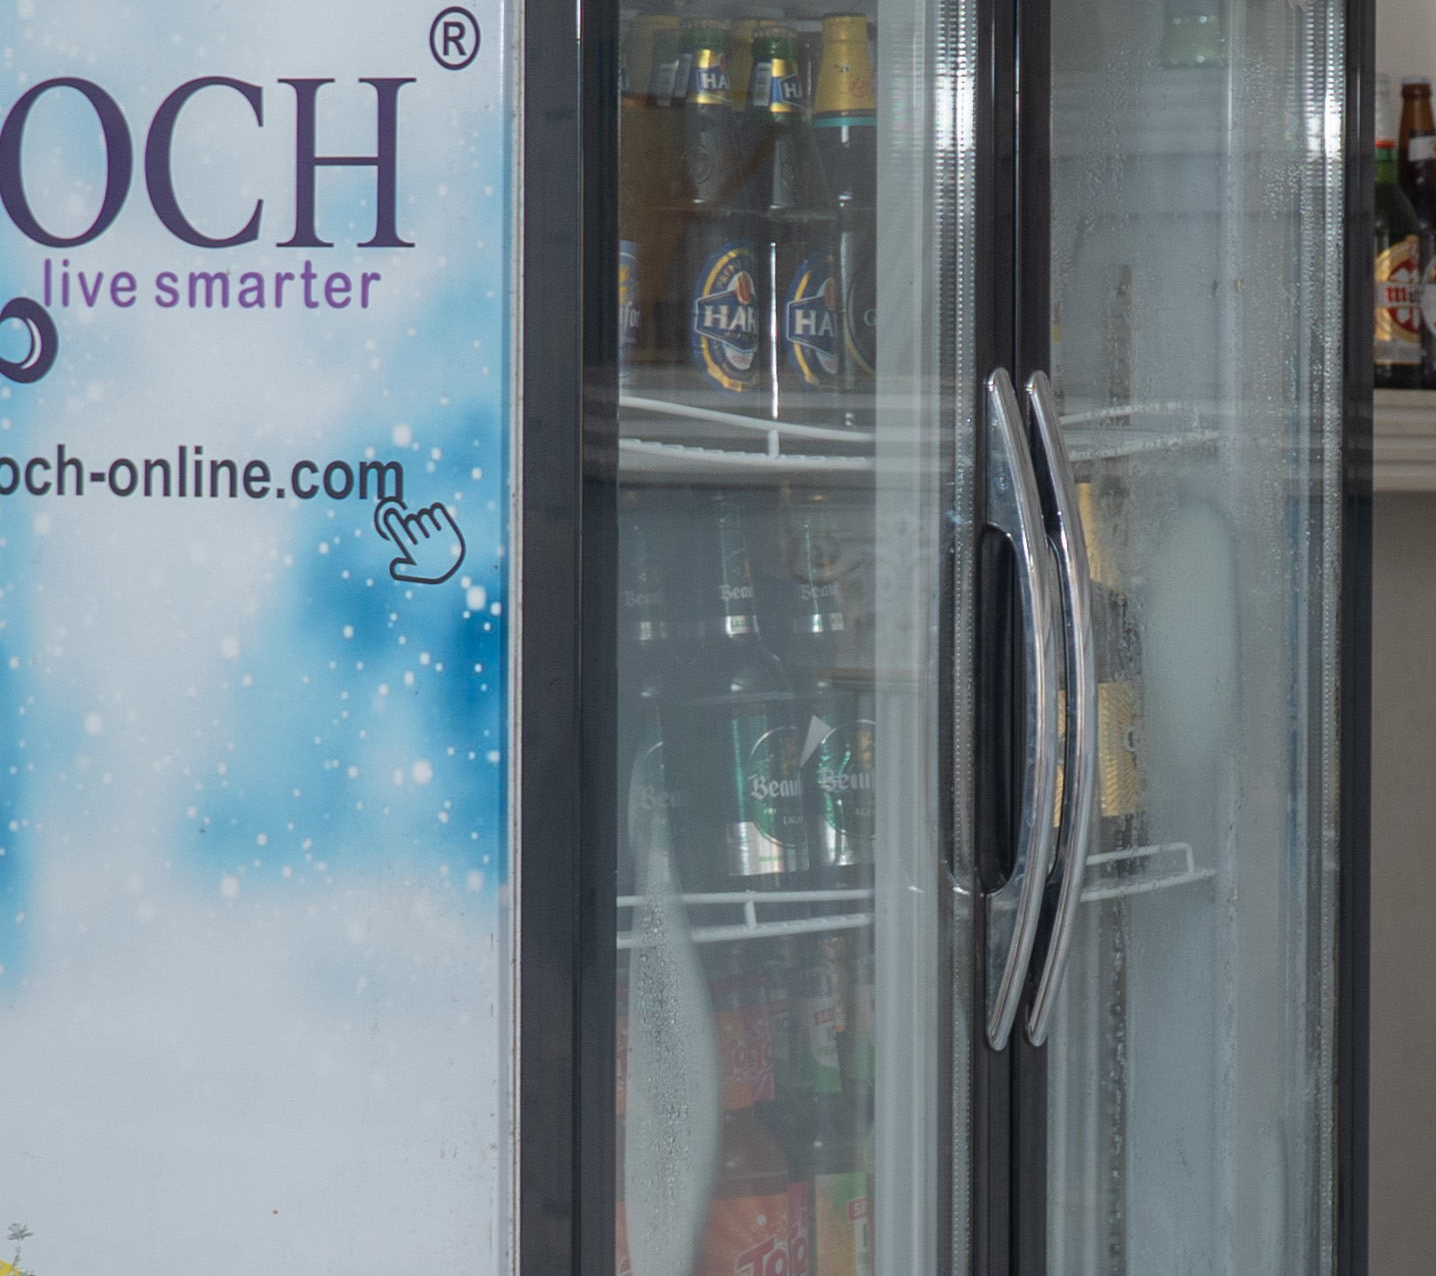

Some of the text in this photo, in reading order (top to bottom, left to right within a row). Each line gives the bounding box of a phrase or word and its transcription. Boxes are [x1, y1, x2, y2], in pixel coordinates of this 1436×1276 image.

[0, 75, 417, 249] OCH
[43, 257, 382, 310] live smarter
[718, 583, 755, 601] Beau
[818, 767, 875, 795] Beau
